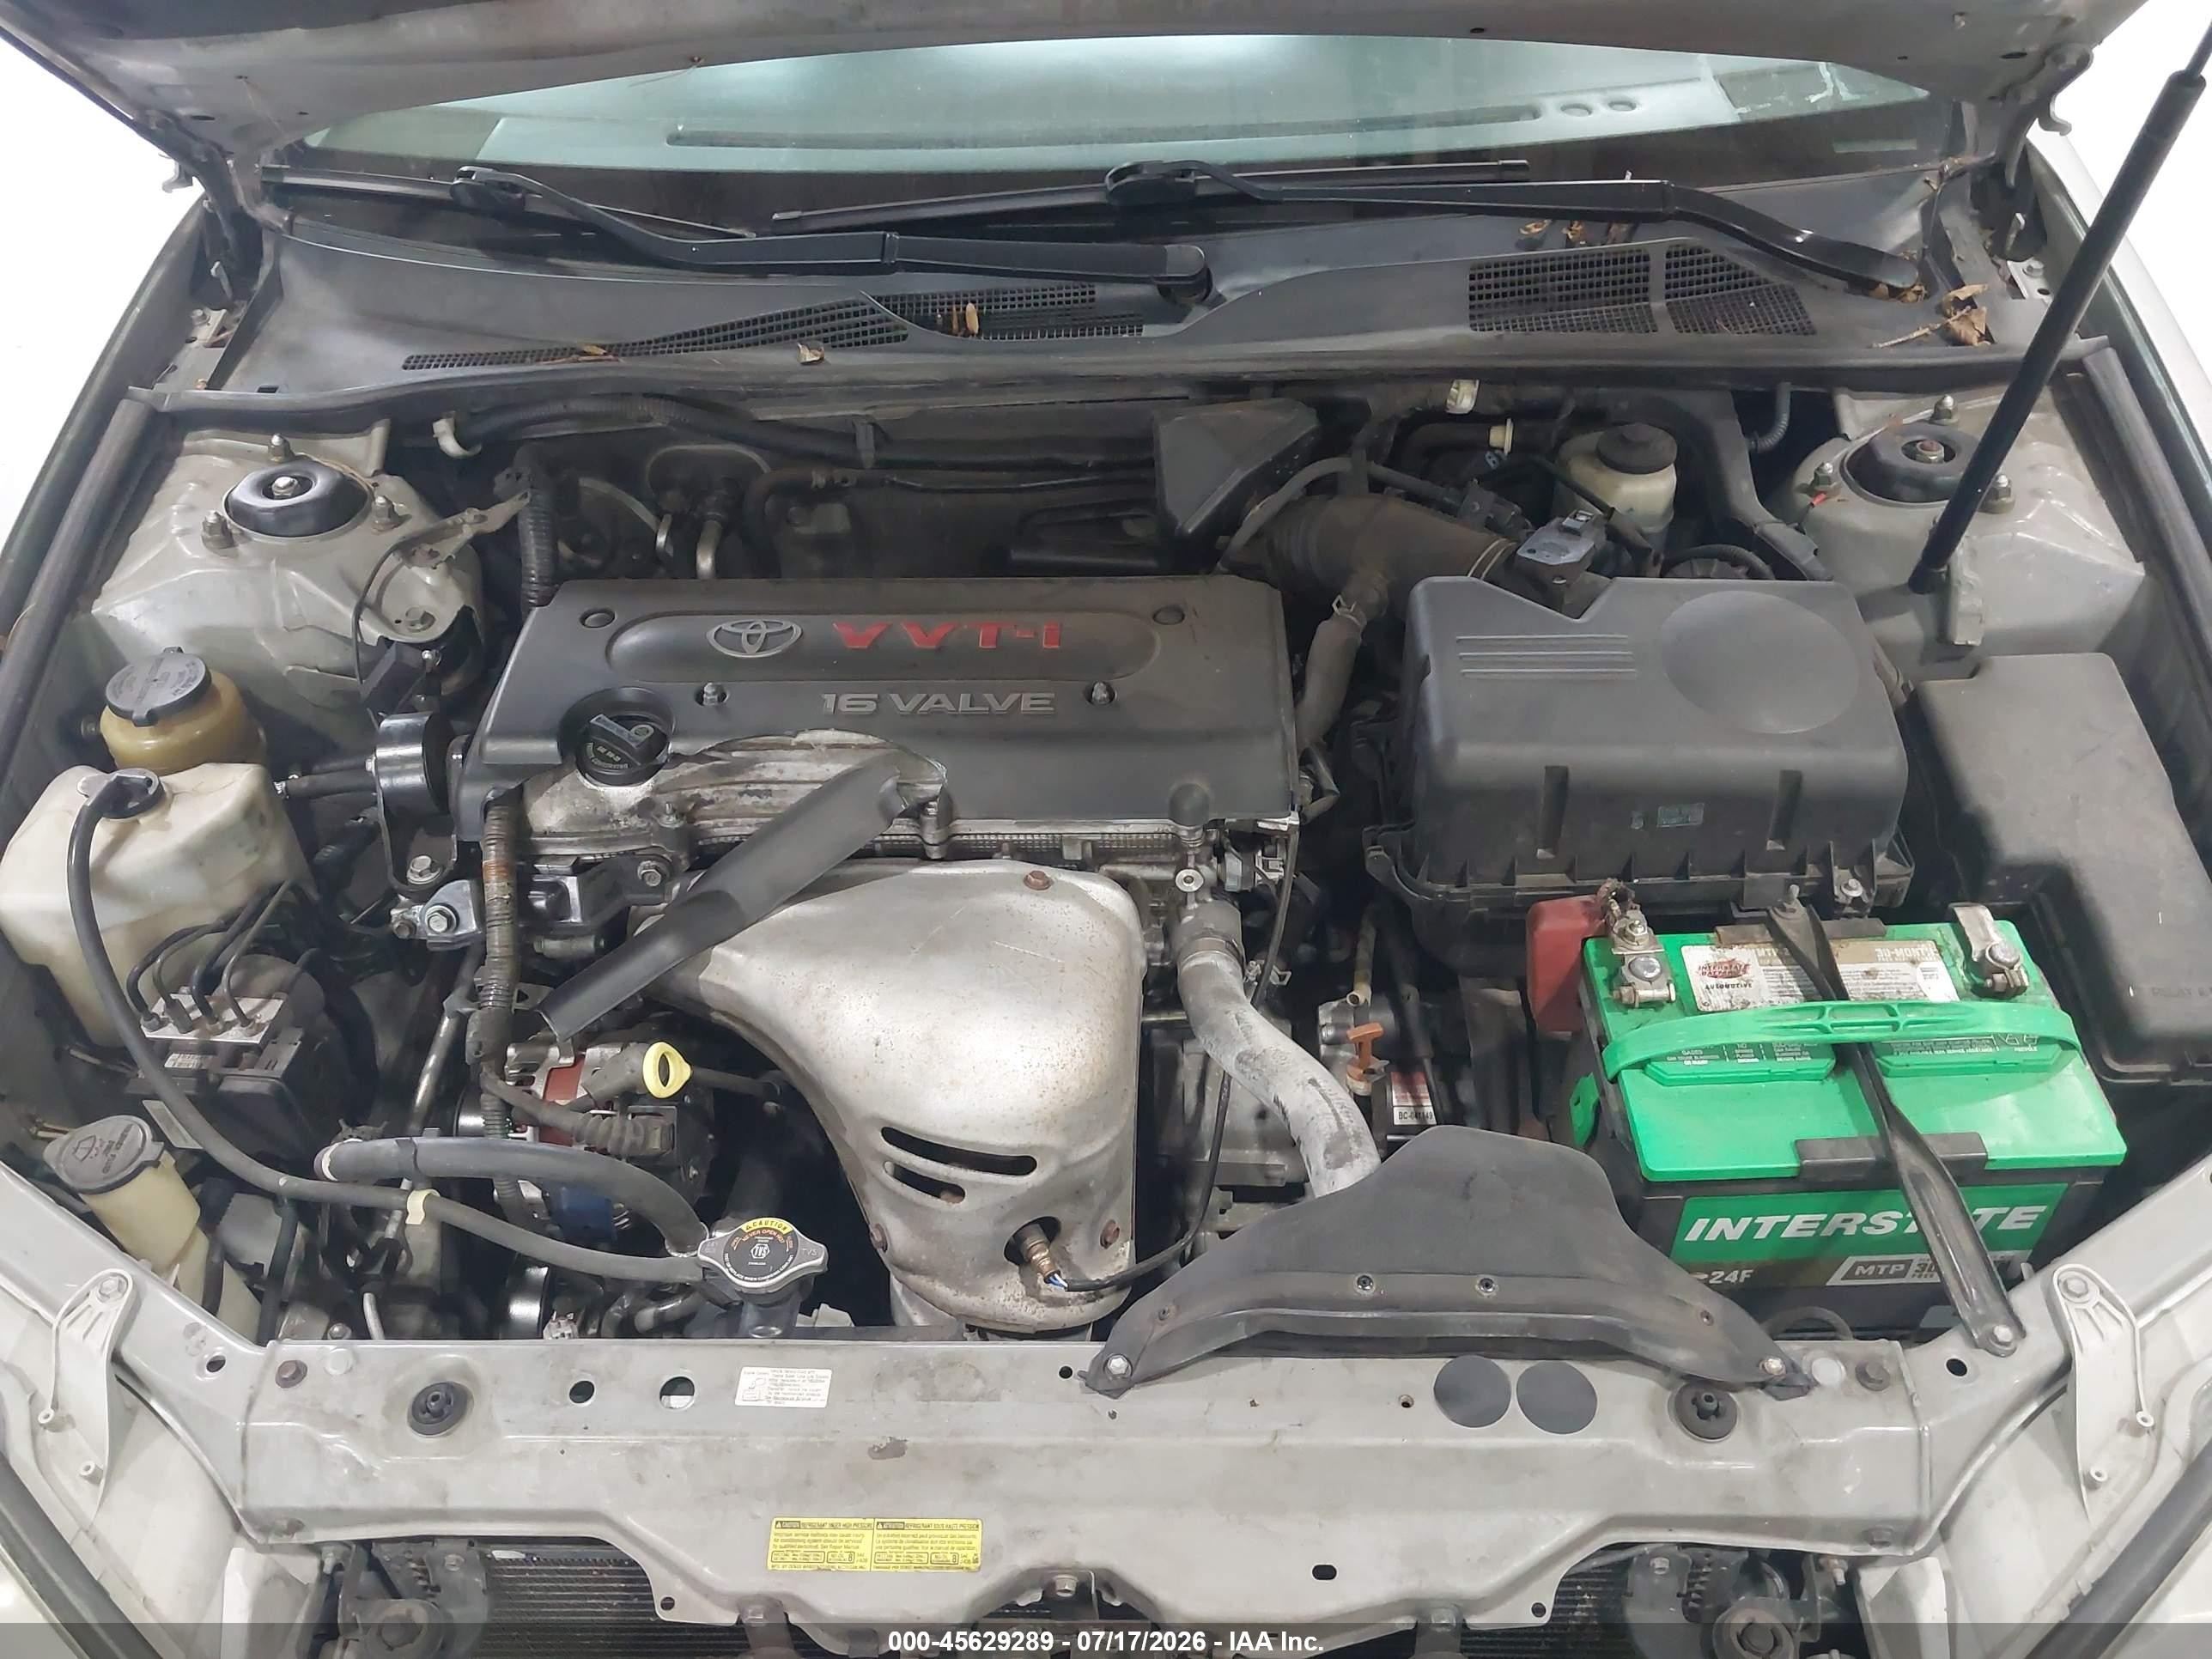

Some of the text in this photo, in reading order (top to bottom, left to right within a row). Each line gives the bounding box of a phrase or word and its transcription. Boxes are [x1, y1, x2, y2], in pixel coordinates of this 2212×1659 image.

[823, 693, 1055, 714] 16 VALVE
[752, 1219, 788, 1231] CAUTION
[1684, 1206, 2047, 1242] INTERSTE
[755, 1245, 768, 1255] TVS
[1854, 1263, 1905, 1276] MTP
